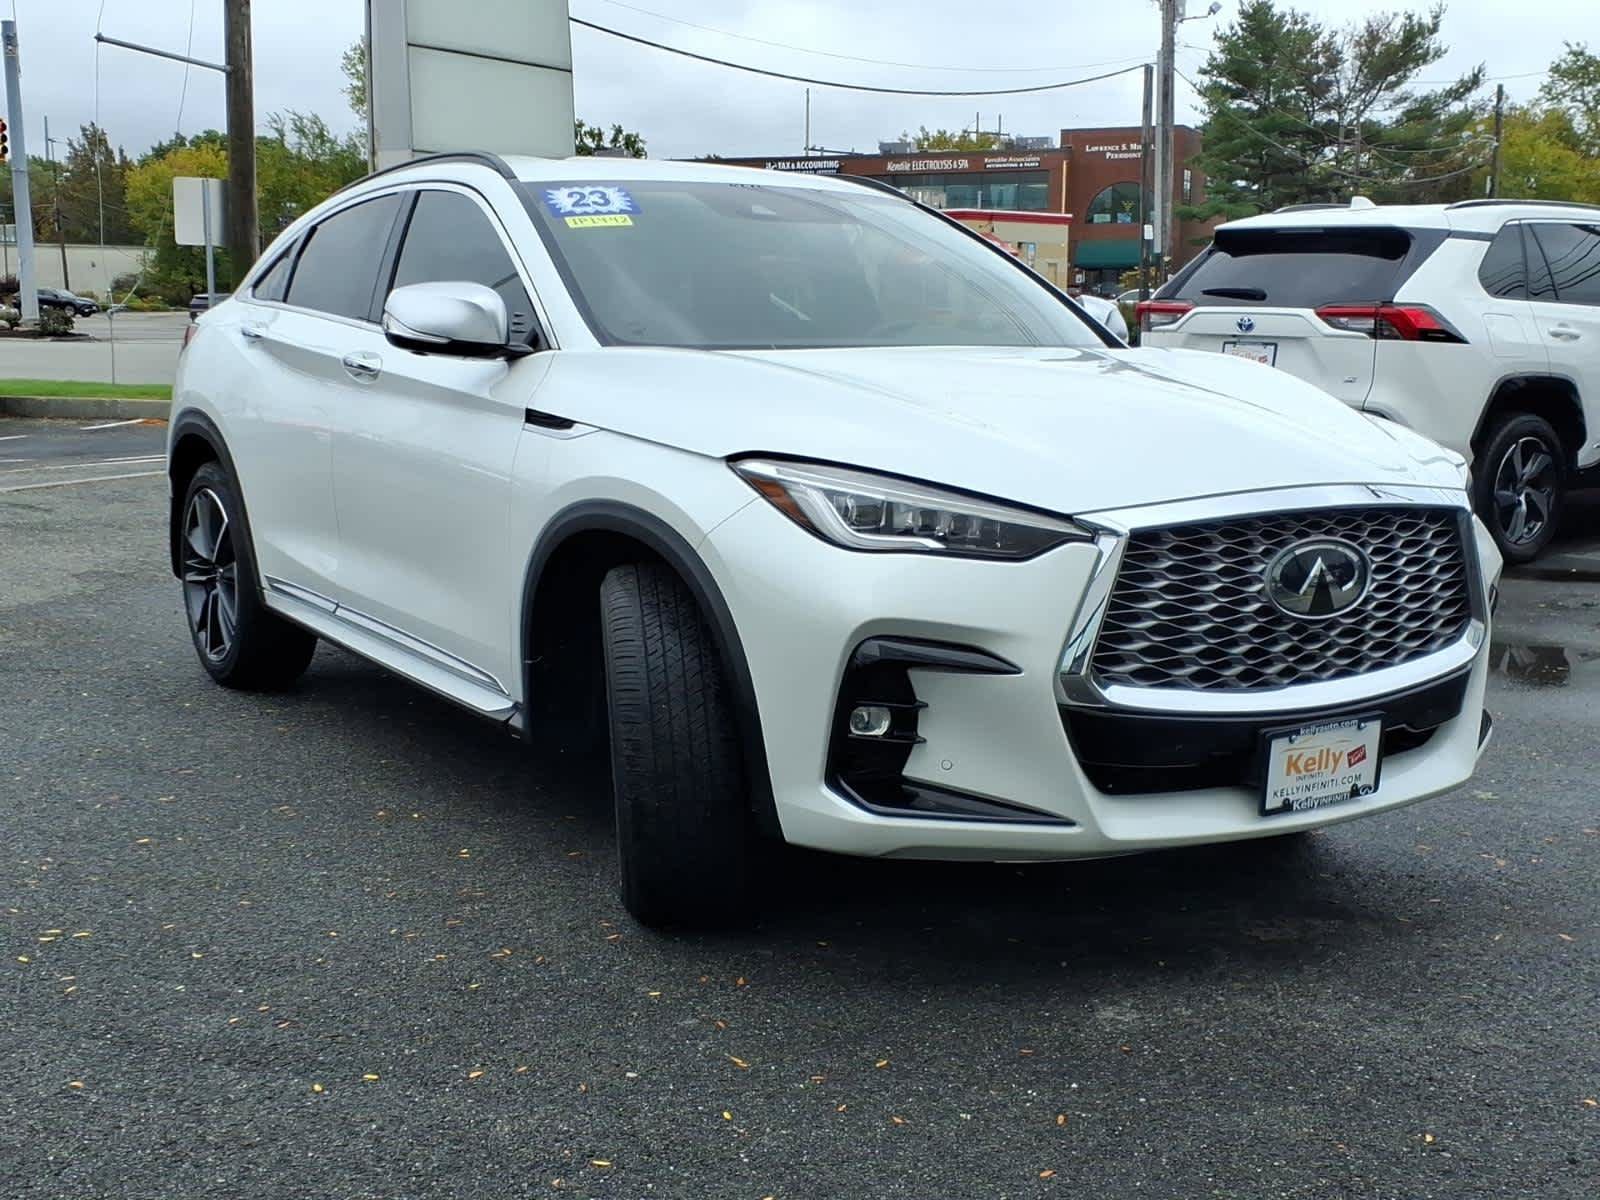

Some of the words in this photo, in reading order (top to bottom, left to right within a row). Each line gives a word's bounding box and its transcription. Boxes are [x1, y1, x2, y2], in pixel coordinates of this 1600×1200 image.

[778, 161, 791, 170] TAX
[796, 160, 840, 169] ACCOUNTING
[912, 159, 952, 171] ELECTROLYSIS
[958, 159, 969, 169] SPA
[567, 190, 611, 208] 23
[1285, 747, 1345, 776] Kelly
[1272, 773, 1362, 799] KELLYINFINITI.COM
